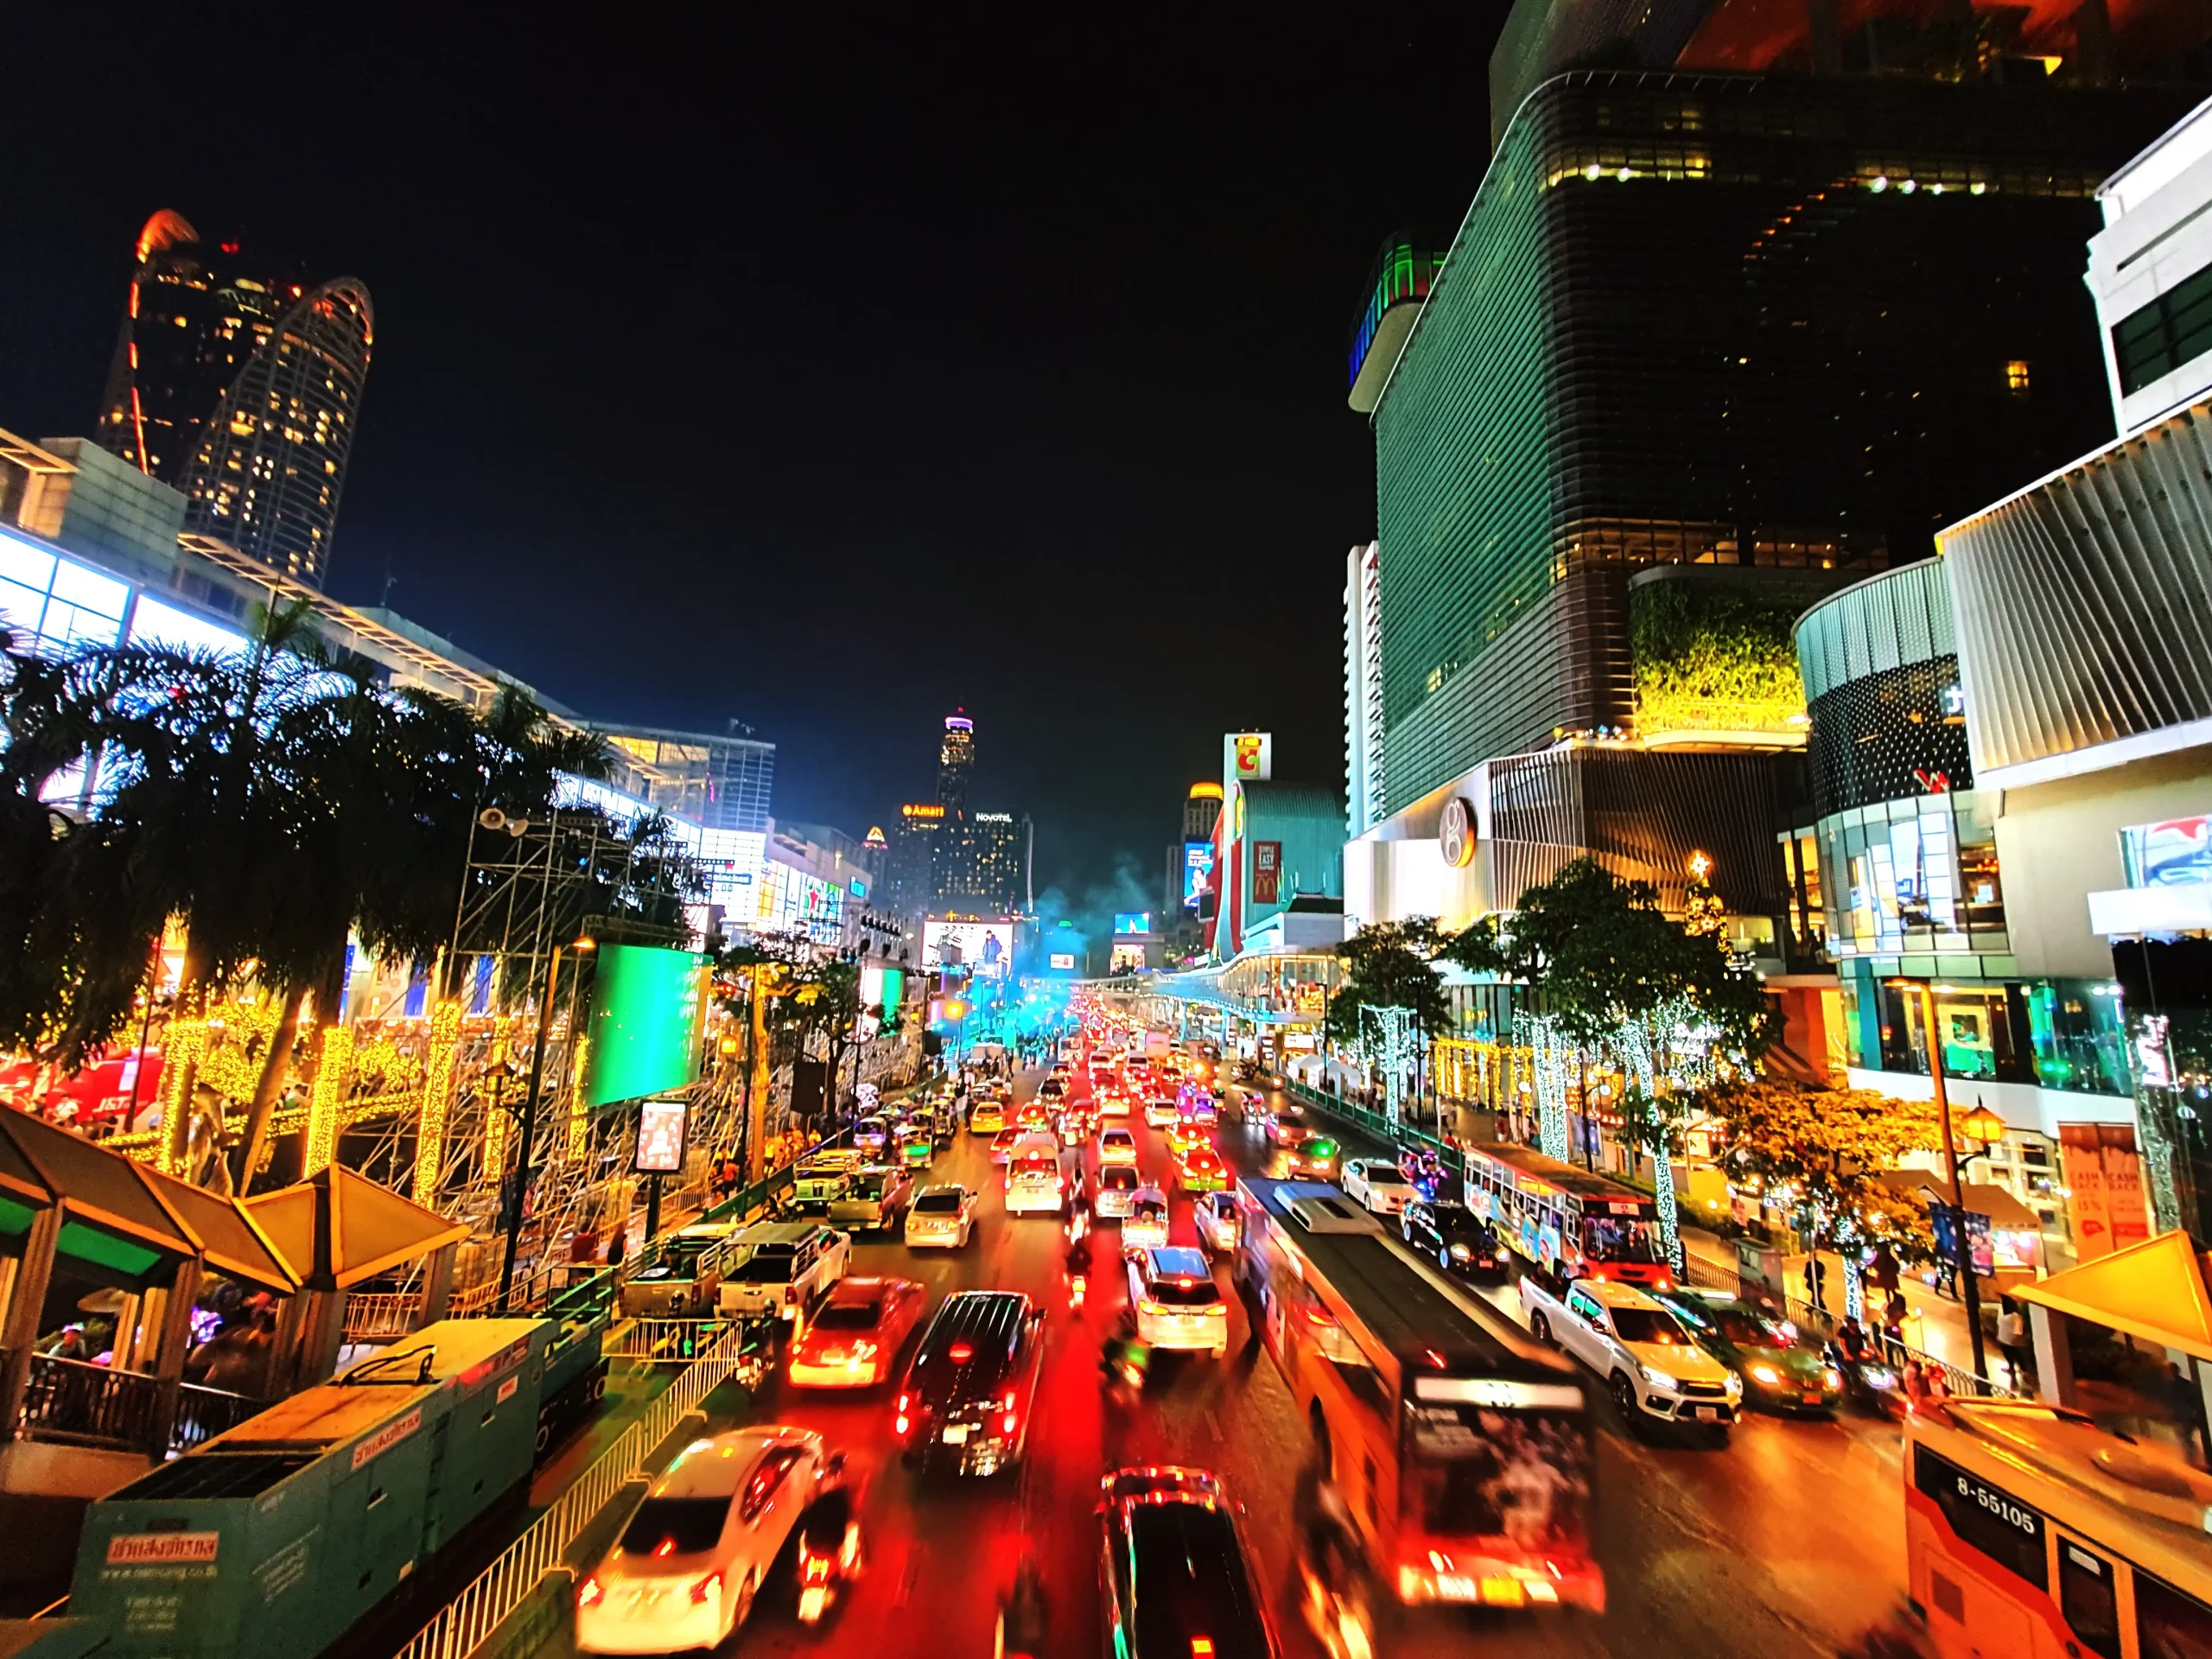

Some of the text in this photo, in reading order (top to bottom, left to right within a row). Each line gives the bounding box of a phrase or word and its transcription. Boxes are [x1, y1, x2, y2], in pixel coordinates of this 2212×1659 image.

[912, 804, 944, 817] Amari
[976, 812, 1013, 823] NOVOTEL
[1258, 854, 1274, 865] EASY
[1957, 1477, 2035, 1534] 8-55105
